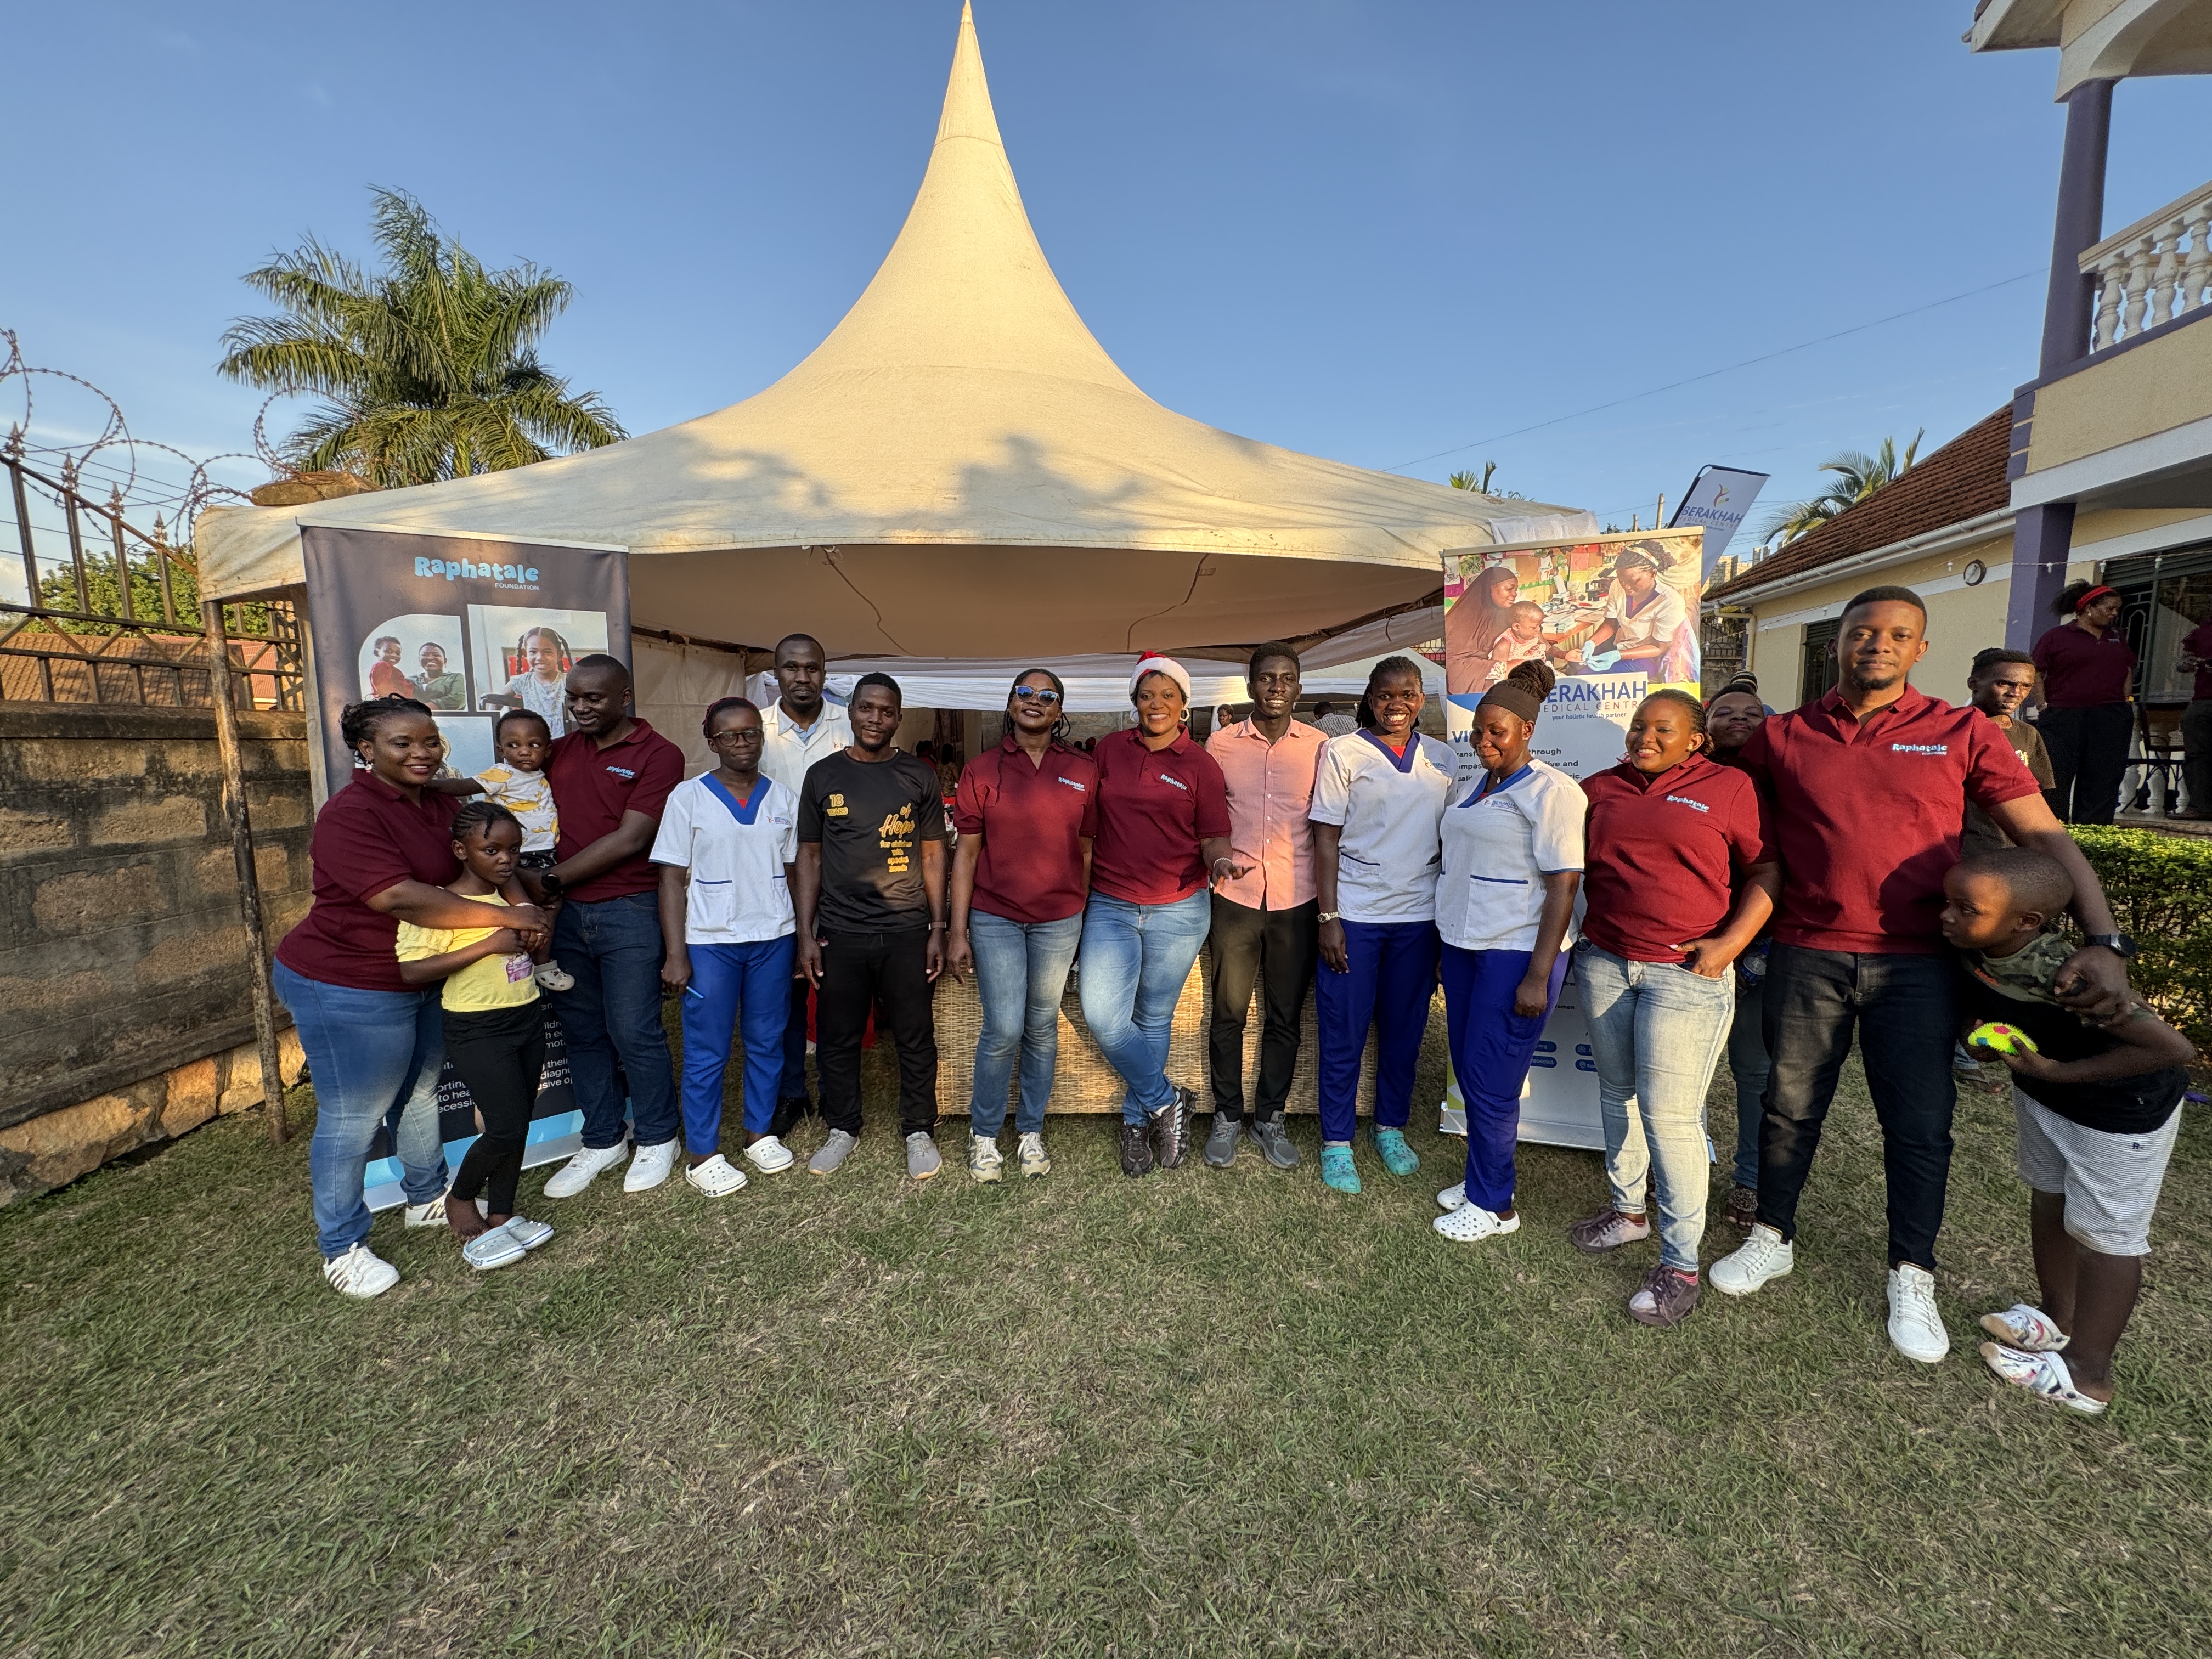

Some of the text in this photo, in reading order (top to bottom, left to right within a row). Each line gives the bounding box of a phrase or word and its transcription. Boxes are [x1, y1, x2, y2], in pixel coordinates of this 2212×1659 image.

[1680, 506, 1745, 523] BERAKHAH
[415, 556, 539, 583] Raphatale
[495, 583, 539, 591] FOUNDATION
[1547, 681, 1646, 703] ERAKHAH
[1539, 700, 1638, 713] EDICAL CENTR
[1160, 774, 1187, 790] Raphatale
[830, 794, 844, 808] 18
[827, 807, 848, 816] YEARS
[900, 803, 911, 819] of
[879, 814, 915, 838] Hope
